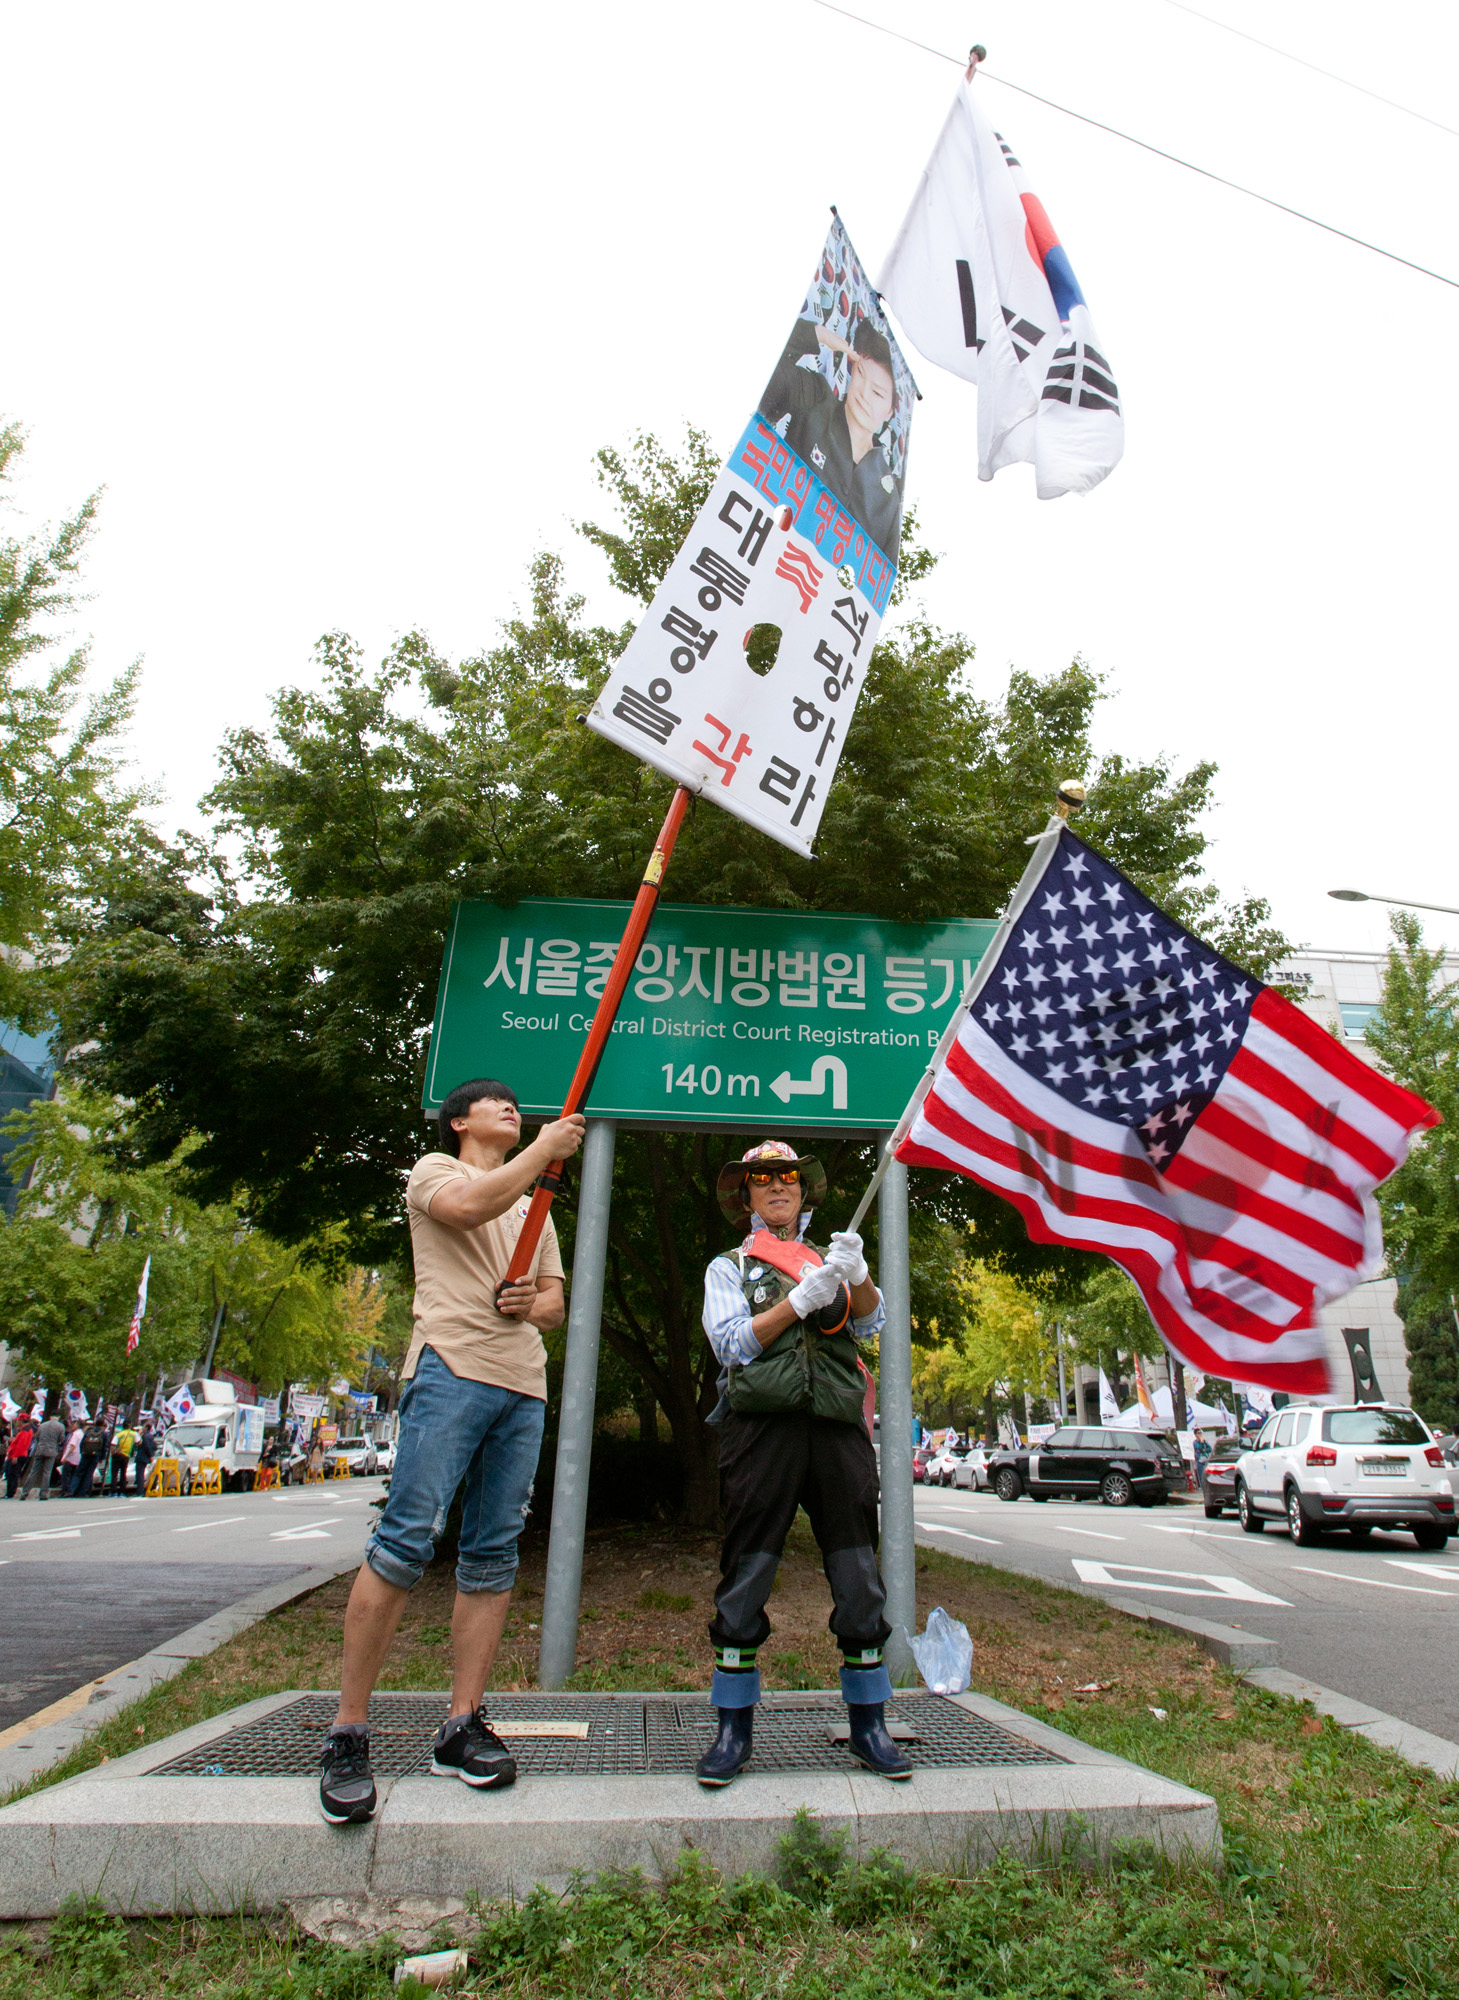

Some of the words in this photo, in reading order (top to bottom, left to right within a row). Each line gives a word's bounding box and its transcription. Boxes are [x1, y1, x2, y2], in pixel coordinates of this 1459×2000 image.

[741, 423, 814, 524] 국민의
[814, 493, 893, 610] 명령이다!
[612, 490, 774, 746] 대통령을
[759, 596, 869, 827] 석방하라
[483, 937, 866, 1010] 서울중앙지방법원
[883, 957, 980, 1016] 등기
[501, 1011, 559, 1032] Seoul
[568, 1013, 645, 1036] Cetral
[652, 1017, 726, 1039] District
[732, 1021, 792, 1042] Court
[798, 1024, 920, 1047] Registration
[661, 1063, 760, 1097] 140m
